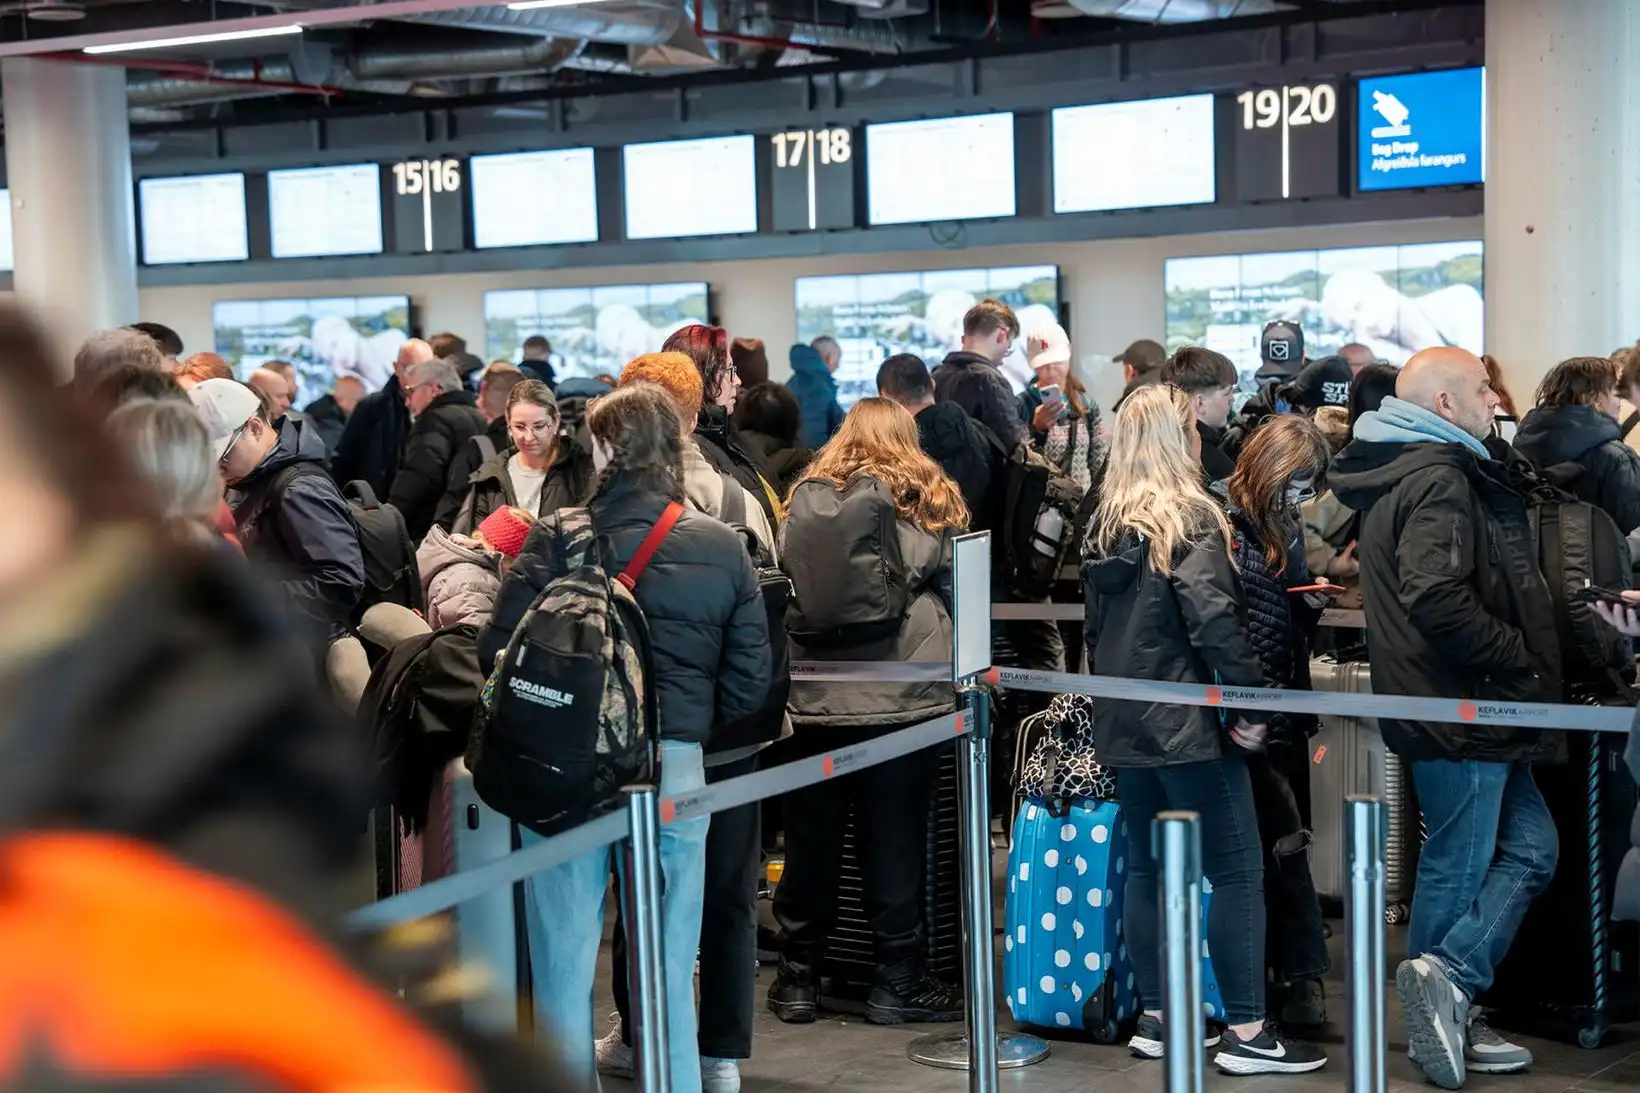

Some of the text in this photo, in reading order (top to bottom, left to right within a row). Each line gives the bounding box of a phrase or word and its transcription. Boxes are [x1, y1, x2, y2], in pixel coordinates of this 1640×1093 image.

[1237, 84, 1336, 130] 19 20
[771, 128, 851, 167] 17 18
[392, 159, 461, 195] 15 16
[508, 676, 575, 705] SCRAMBLE
[1222, 690, 1256, 700] KEFLAVIK
[1478, 705, 1517, 715] KEFLAVIK
